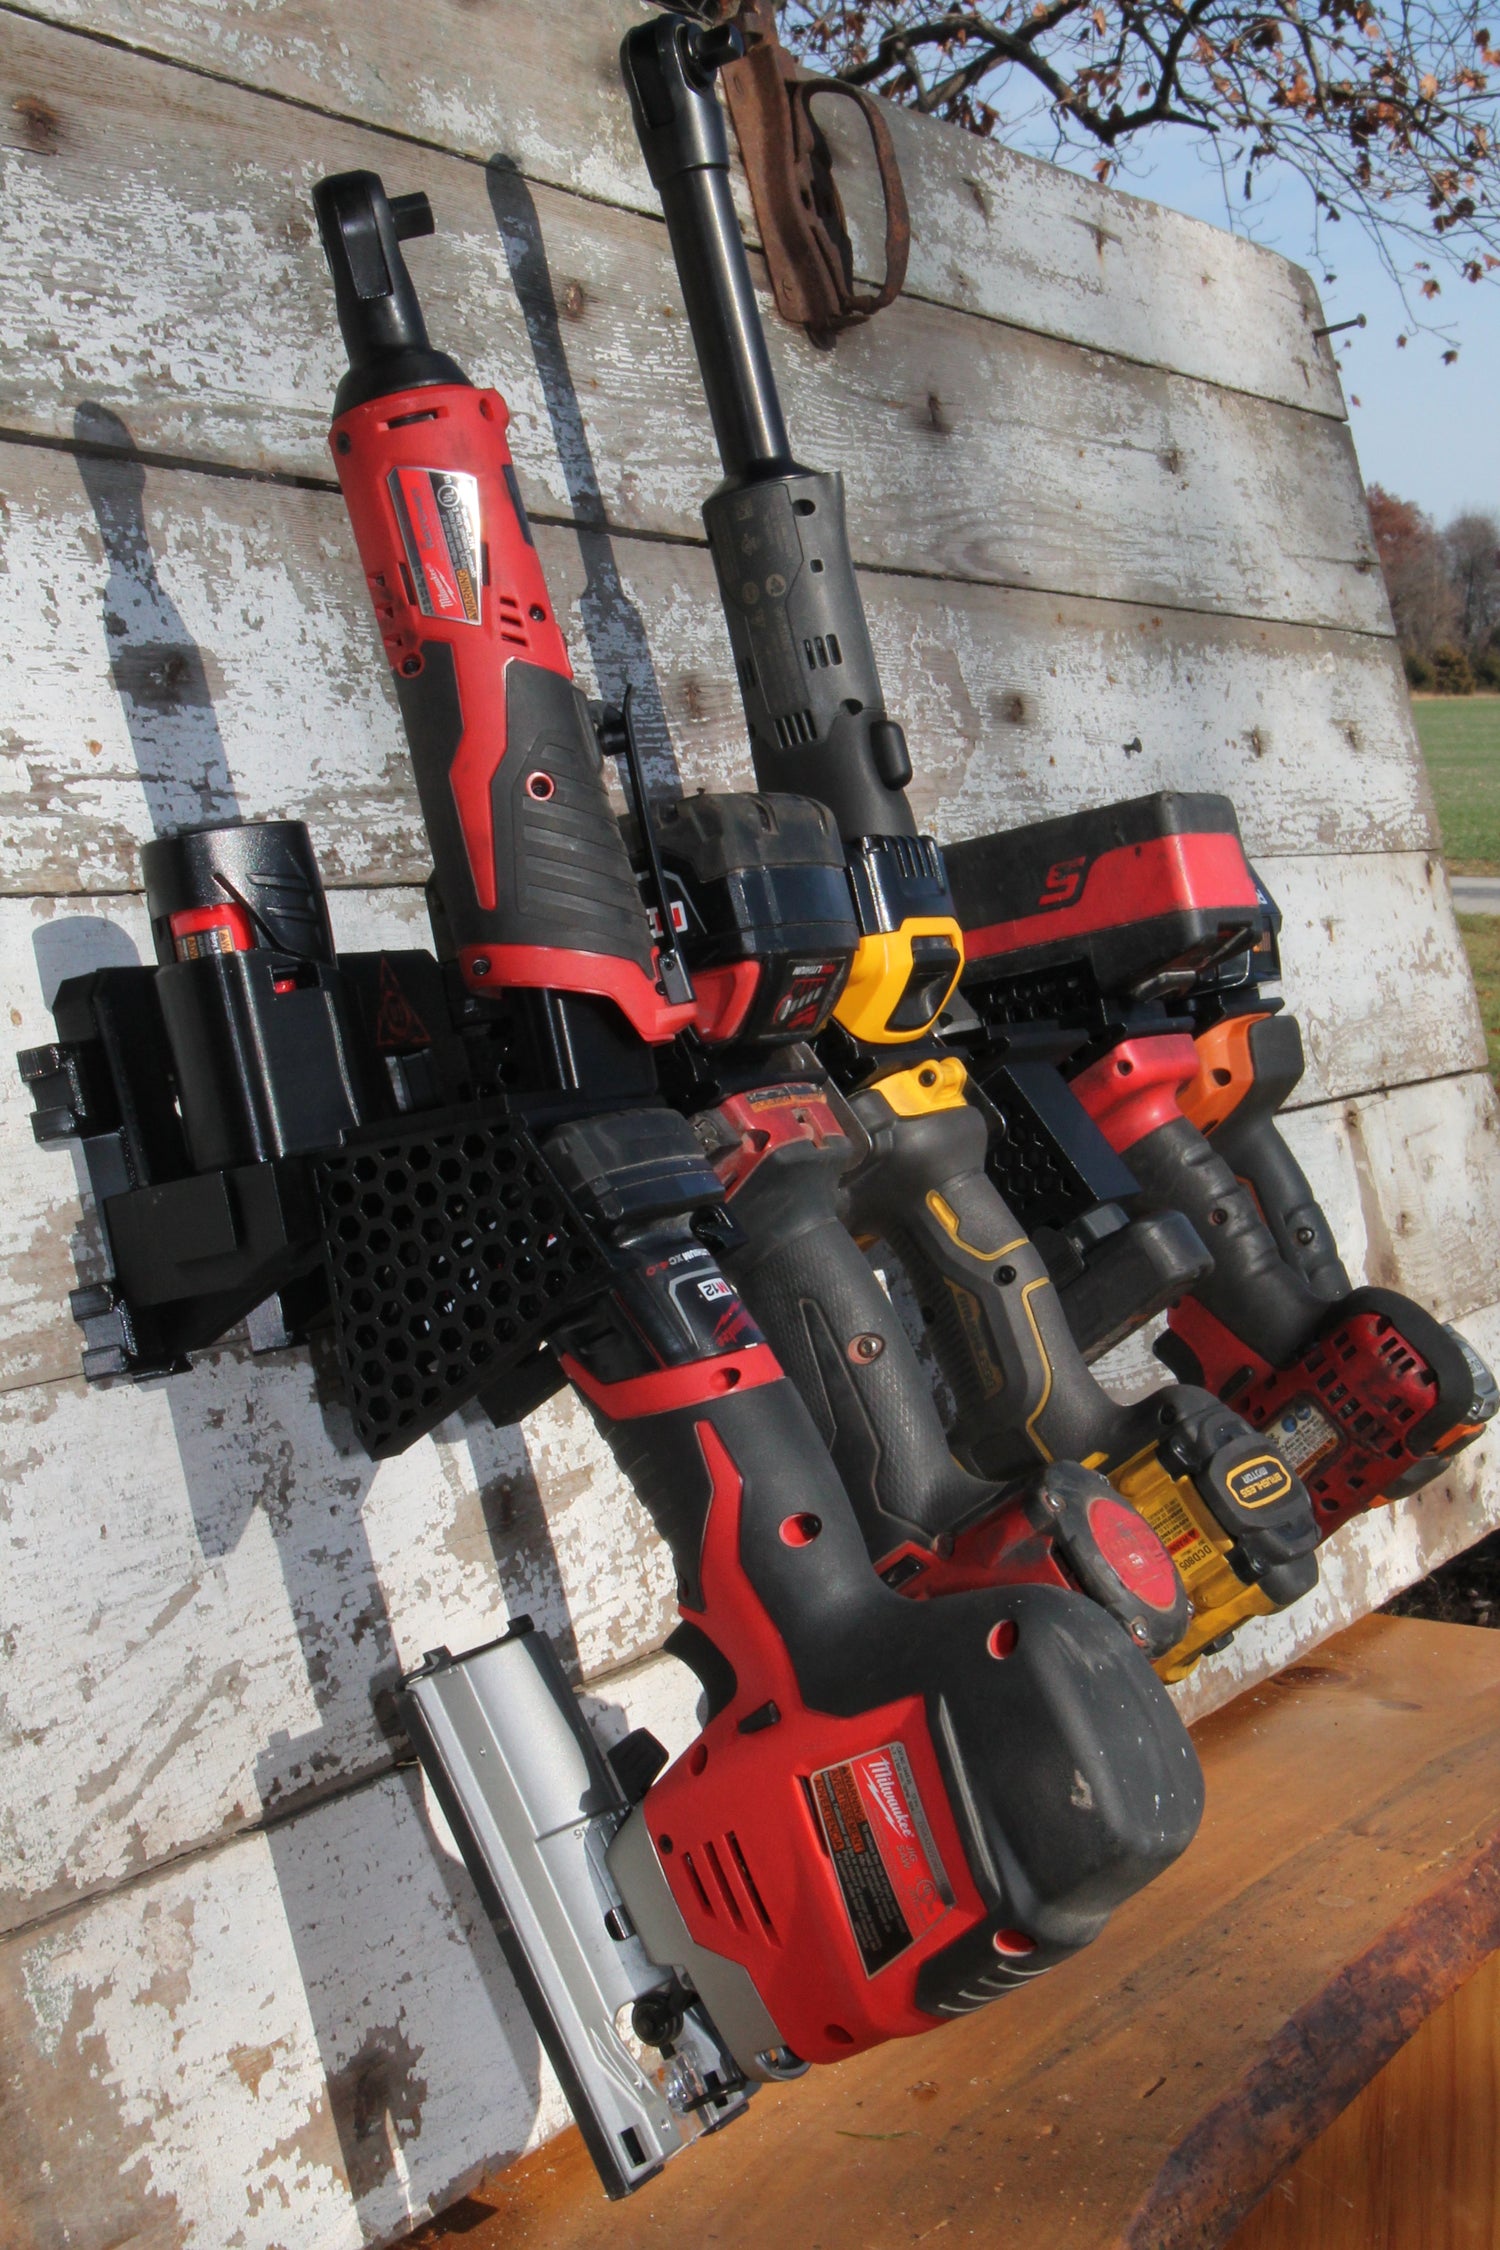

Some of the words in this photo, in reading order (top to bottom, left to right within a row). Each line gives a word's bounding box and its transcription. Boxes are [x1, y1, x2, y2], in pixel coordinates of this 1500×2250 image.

[458, 570, 477, 613] WARNING
[702, 1280, 730, 1297] M12
[1239, 1472, 1283, 1498] BRUSHLESS
[1241, 1466, 1268, 1484] MOTOR
[1178, 1545, 1212, 1571] DCD805
[828, 1769, 864, 1850] AVERTISSEMENT
[842, 1774, 866, 1821] WARNING
[869, 1755, 913, 1837] Milwaukee
[814, 1779, 843, 1849] ADVERTENCIA
[896, 1844, 912, 1870] SAW
